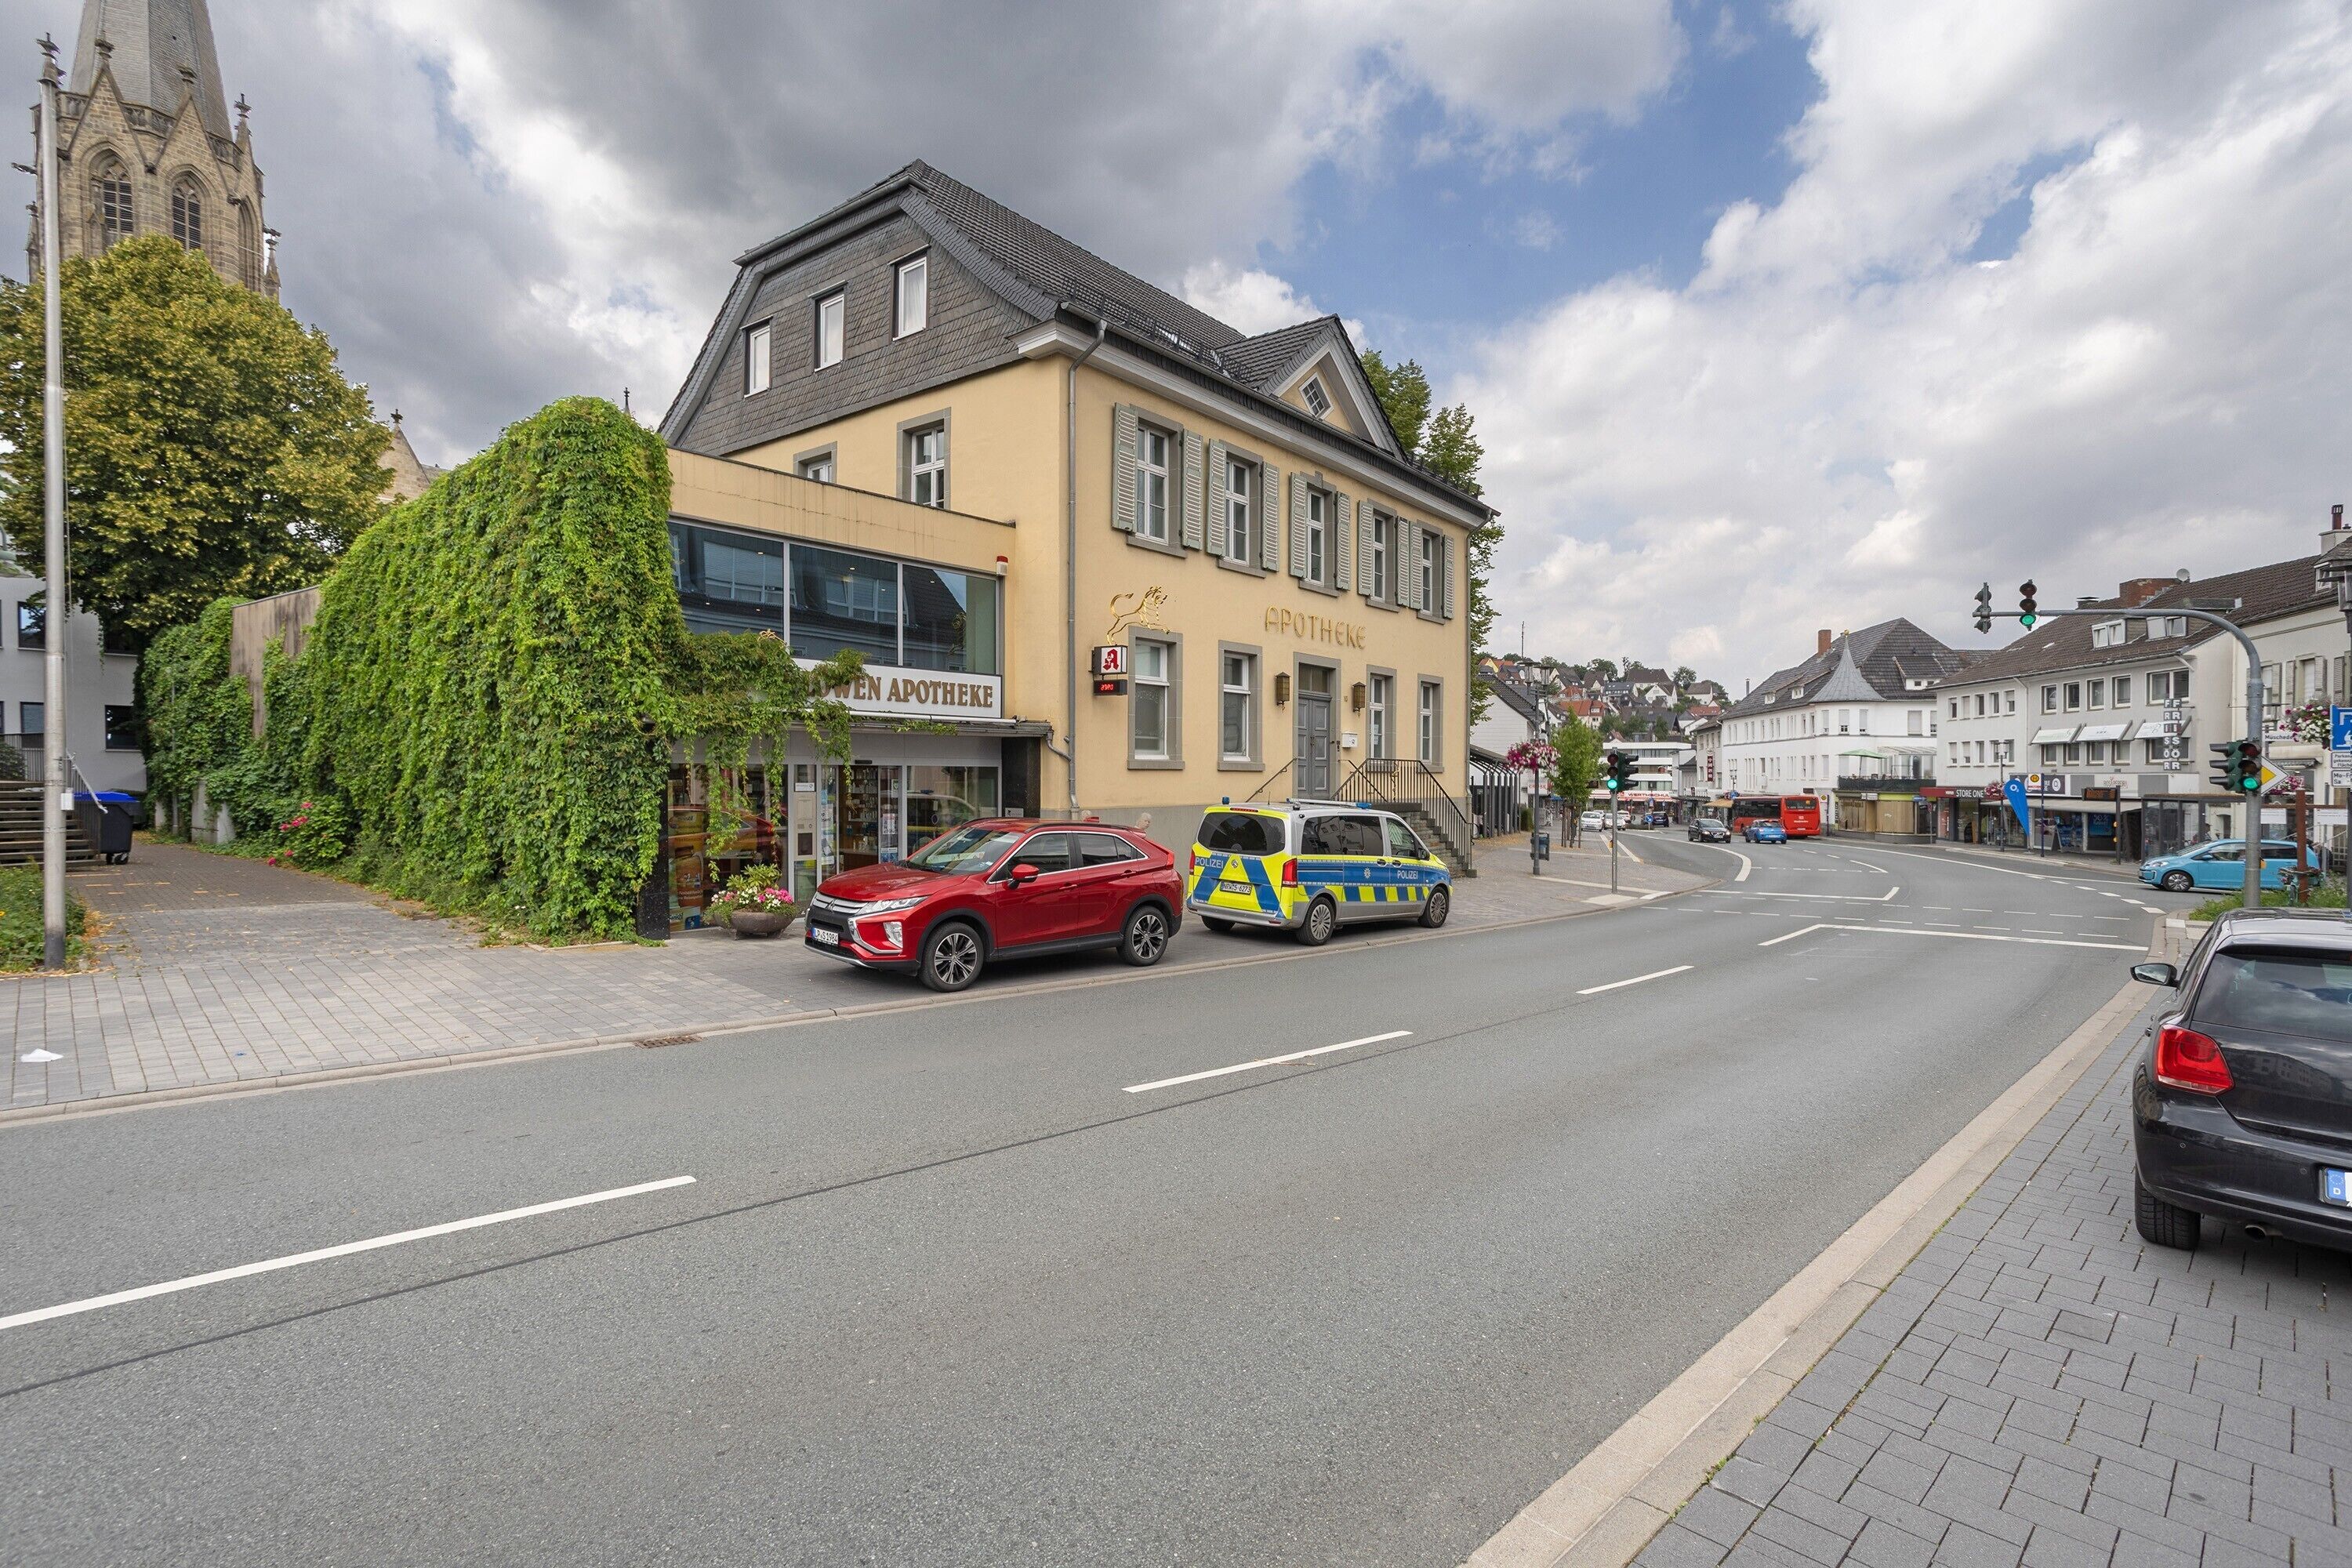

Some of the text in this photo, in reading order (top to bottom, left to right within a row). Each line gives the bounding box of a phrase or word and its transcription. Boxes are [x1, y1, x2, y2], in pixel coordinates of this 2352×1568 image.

[1265, 606, 1366, 650] APOTHEKE
[887, 677, 993, 708] APOTHEKE
[2171, 699, 2181, 770] FRISÖR
[1956, 789, 1973, 798] STORE
[1973, 789, 1984, 798] ONE
[1196, 857, 1224, 869] POLIZEI
[1397, 870, 1418, 880] POLIZEI
